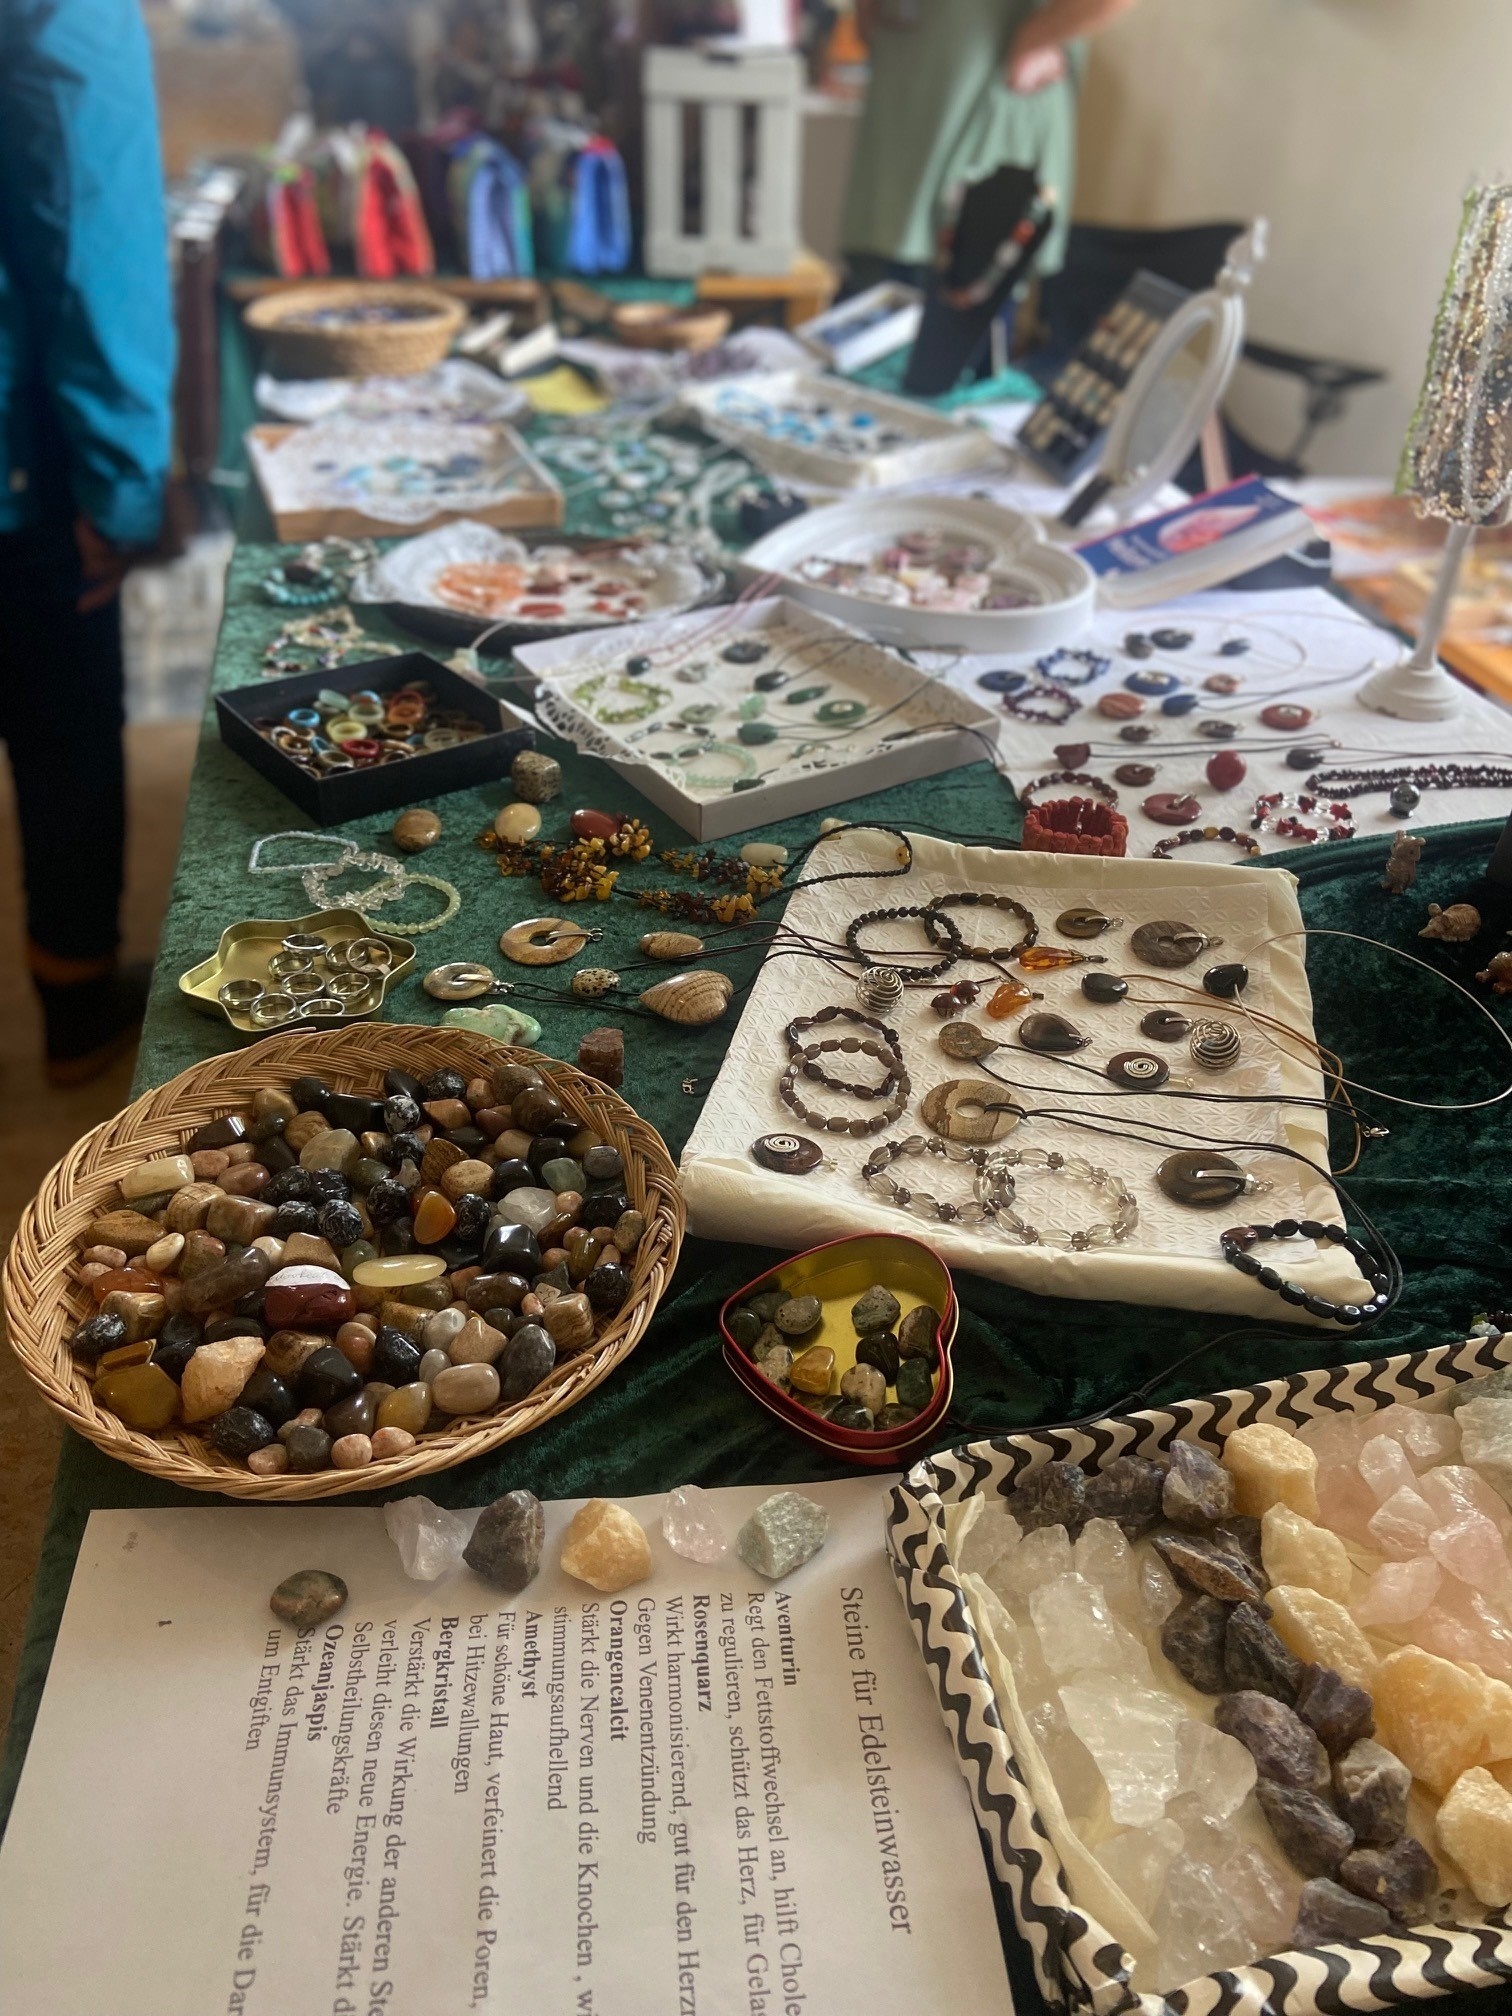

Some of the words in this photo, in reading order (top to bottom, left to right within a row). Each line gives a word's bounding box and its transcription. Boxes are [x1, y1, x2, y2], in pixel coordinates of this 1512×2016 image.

[468, 1613, 489, 1640] bei
[496, 1611, 517, 1640] Für
[580, 1602, 601, 1656] Stärkt
[632, 1597, 656, 1657] Gegen
[665, 1594, 685, 1648] Wirkt
[719, 1592, 734, 1613] zu
[744, 1591, 767, 1633] Regt
[839, 1587, 869, 1661] Steine
[263, 1628, 282, 1659] um
[288, 1626, 318, 1682] Stärkt
[375, 1618, 400, 1688] verleiht
[403, 1616, 432, 1699] Verstärkt
[516, 1609, 544, 1699] Amethyst
[690, 1593, 713, 1713] Rosenquarz
[717, 1617, 744, 1720] regulieren,
[751, 1636, 771, 1672] den
[774, 1590, 801, 1687] Aventurin
[281, 1685, 305, 1717] das
[304, 1624, 345, 1742] Ozeanjaspis
[429, 1615, 460, 1730] Bergkristall
[490, 1644, 513, 1707] schöne
[580, 1659, 600, 1690] die
[604, 1599, 630, 1742] Orangencalcit
[850, 1668, 878, 1706] für
[244, 1662, 281, 1752] Entgiften
[325, 1621, 374, 1816] Selbstheilungskräfte
[365, 1692, 393, 1754] diesen
[399, 1703, 422, 1732] die
[450, 1643, 487, 1795] Hitzewallungen
[545, 1606, 572, 1812] stimmungsaufhellend
[579, 1693, 600, 1770] Nerven
[666, 1651, 693, 1816] harmonisierend,
[483, 1711, 510, 1767] Haut,
[635, 1659, 662, 1845] Venenentzündung
[728, 1725, 751, 1800] schützt
[754, 1675, 790, 1844] Fettstoffwechsel
[247, 1720, 299, 1877] Immunsystem,
[358, 1757, 378, 1808] neue
[382, 1735, 418, 1829] Wirkung
[578, 1774, 600, 1816] und
[383, 1833, 407, 1871] der
[479, 1771, 505, 1880] verfeinert
[577, 1821, 600, 1855] die
[667, 1821, 692, 1857] gut
[734, 1805, 756, 1840] das
[857, 1713, 913, 1936] Edelsteinwasser
[343, 1813, 378, 1908] Energie.
[674, 1860, 696, 1896] für
[737, 1844, 760, 1906] Herz,
[768, 1849, 787, 1882] an,
[245, 1882, 272, 1918] für
[371, 1876, 401, 1973] anderen
[477, 1885, 501, 1922] die
[576, 1860, 600, 1969] Knochen
[674, 1900, 698, 1944] den
[742, 1912, 766, 1947] für
[773, 1886, 800, 1937] hilft
[237, 1923, 264, 1961] die
[335, 1915, 366, 1991] Stärkt
[467, 1929, 498, 2009] Poren,
[332, 1996, 357, 2016] d
